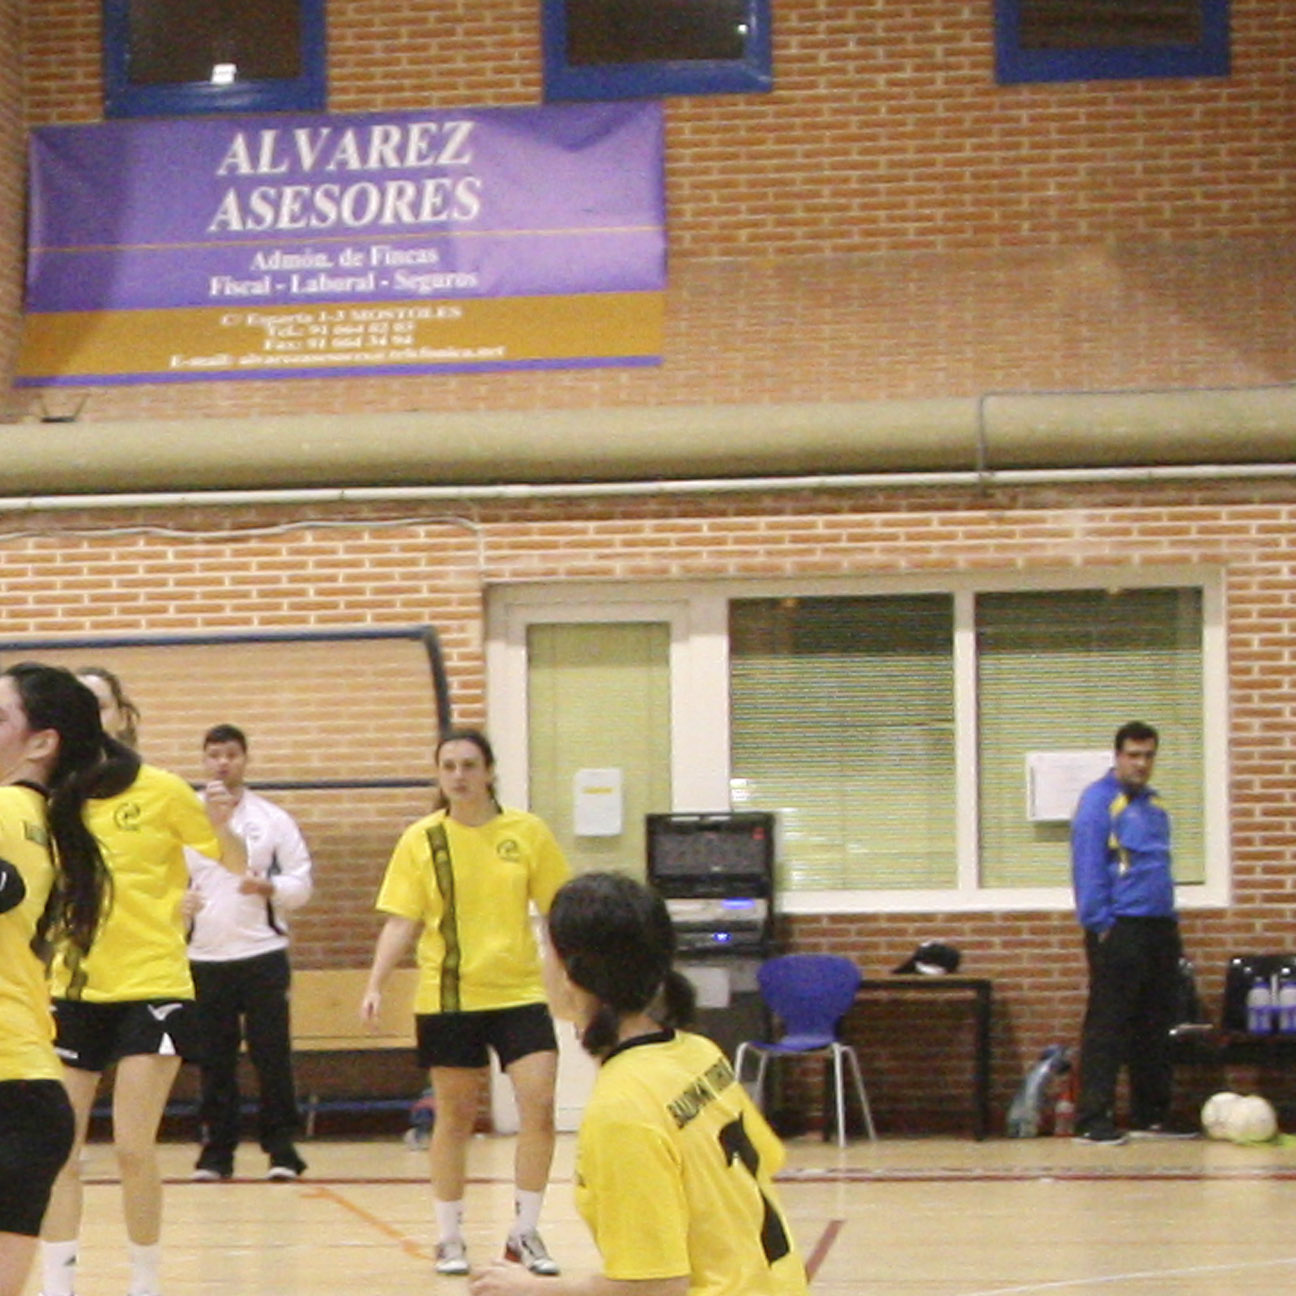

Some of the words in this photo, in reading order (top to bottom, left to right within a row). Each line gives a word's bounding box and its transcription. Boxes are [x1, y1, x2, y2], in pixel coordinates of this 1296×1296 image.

[215, 121, 476, 176] ALVAREZ
[208, 177, 482, 232] ASESORES
[338, 248, 364, 267] de
[369, 246, 440, 266] Fincas
[209, 274, 272, 297] Fiscal
[289, 270, 377, 293] Laboral
[392, 269, 480, 295] Seguros
